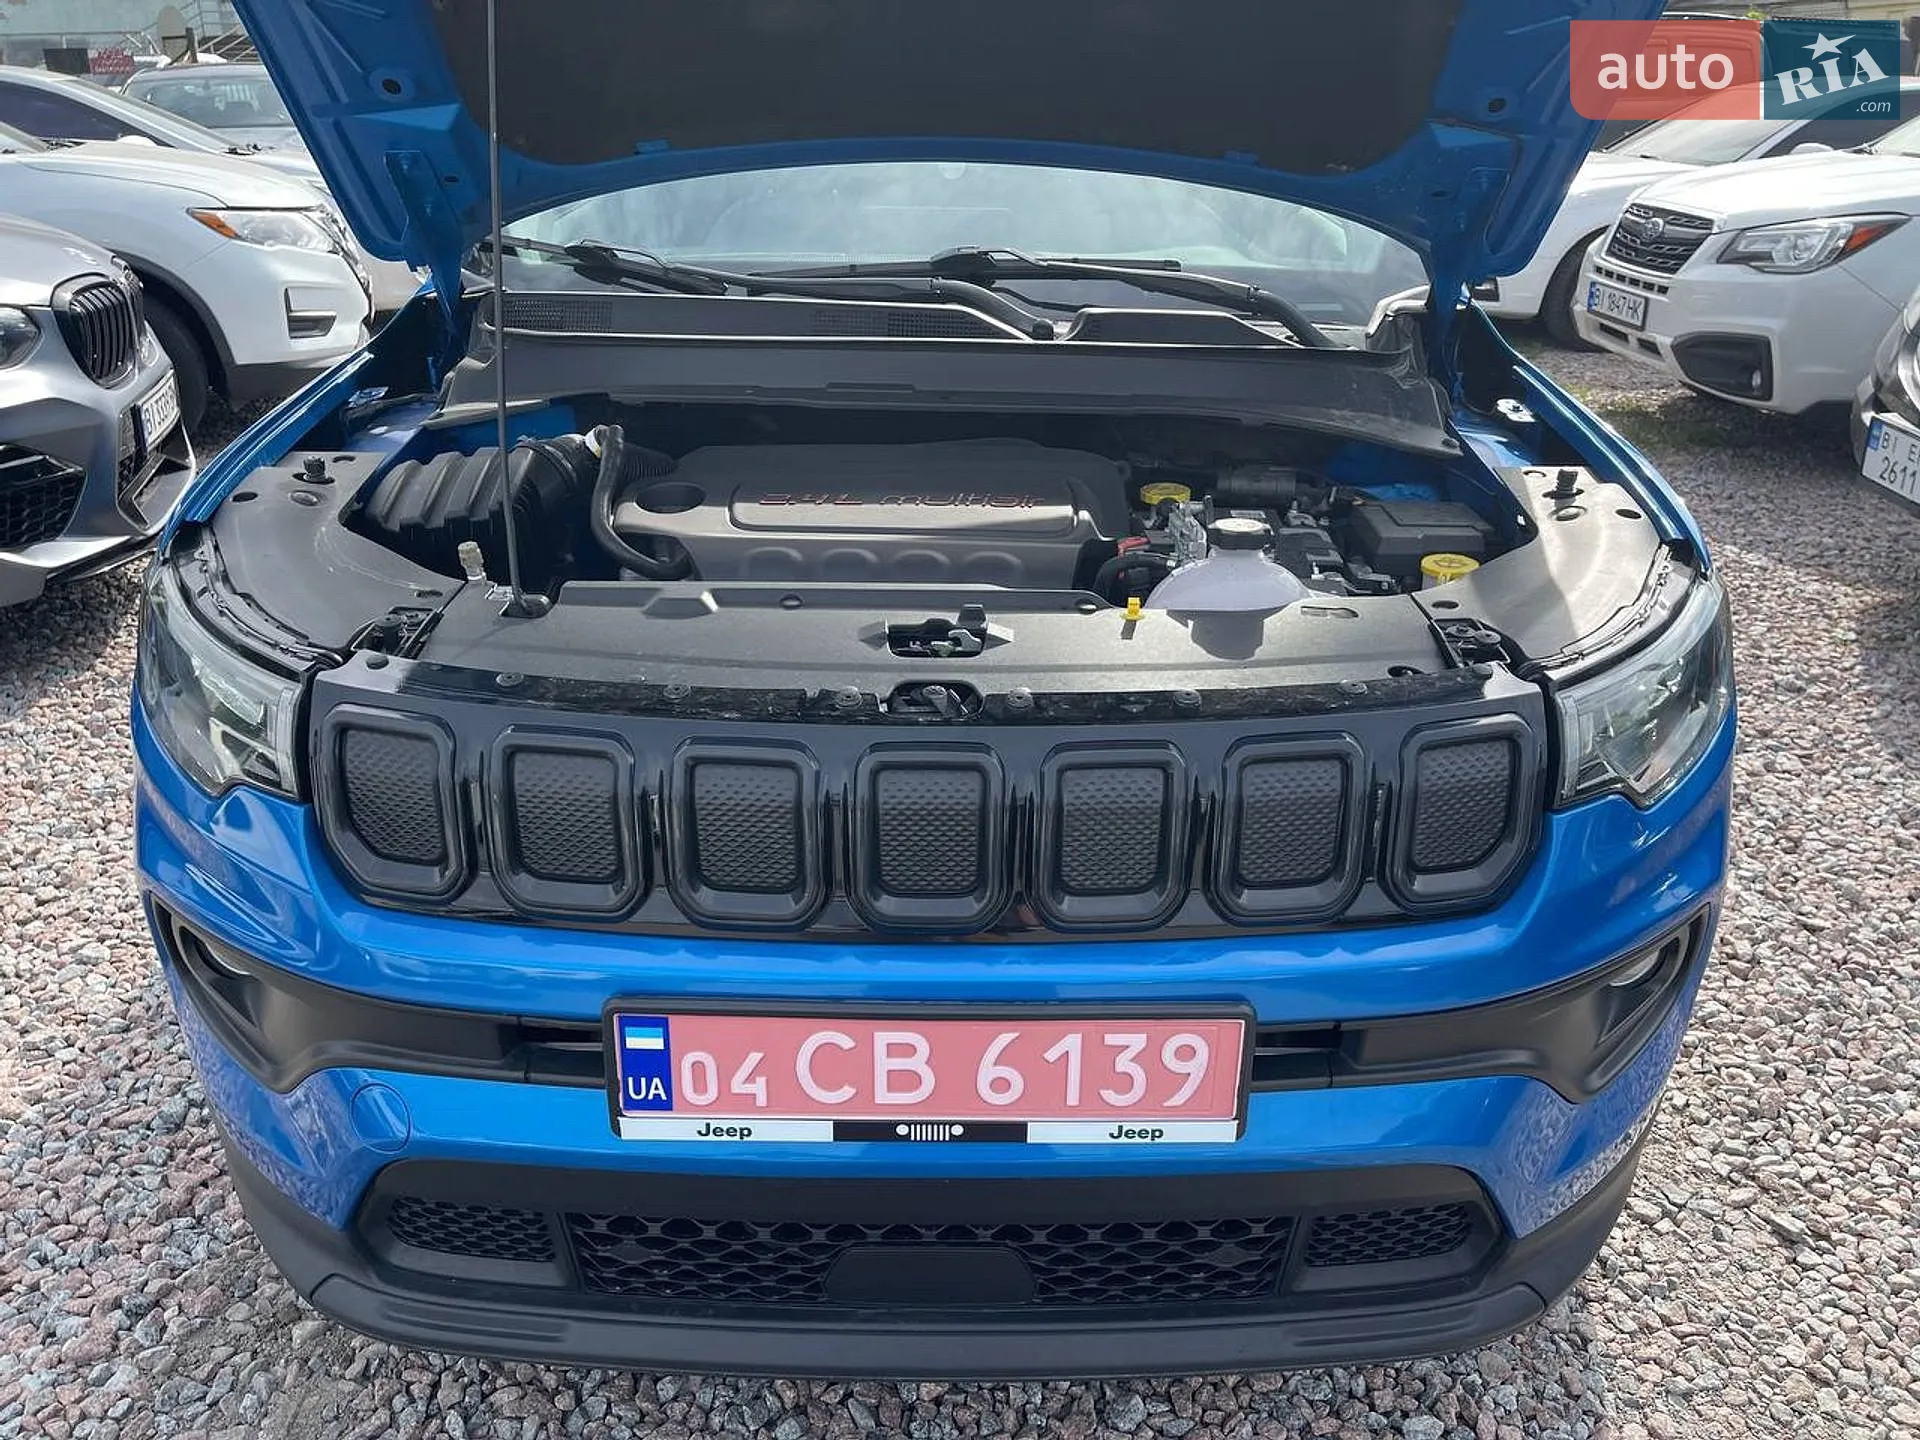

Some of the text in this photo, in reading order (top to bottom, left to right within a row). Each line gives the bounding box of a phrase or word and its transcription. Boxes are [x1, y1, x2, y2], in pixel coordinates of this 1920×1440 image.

[1908, 443, 1920, 467] E
[1880, 455, 1917, 493] 2611
[681, 1030, 1210, 1108] 04 CB 6139
[628, 1077, 667, 1100] UA
[697, 1122, 753, 1140] Jeep
[1108, 1125, 1164, 1141] Jeep
